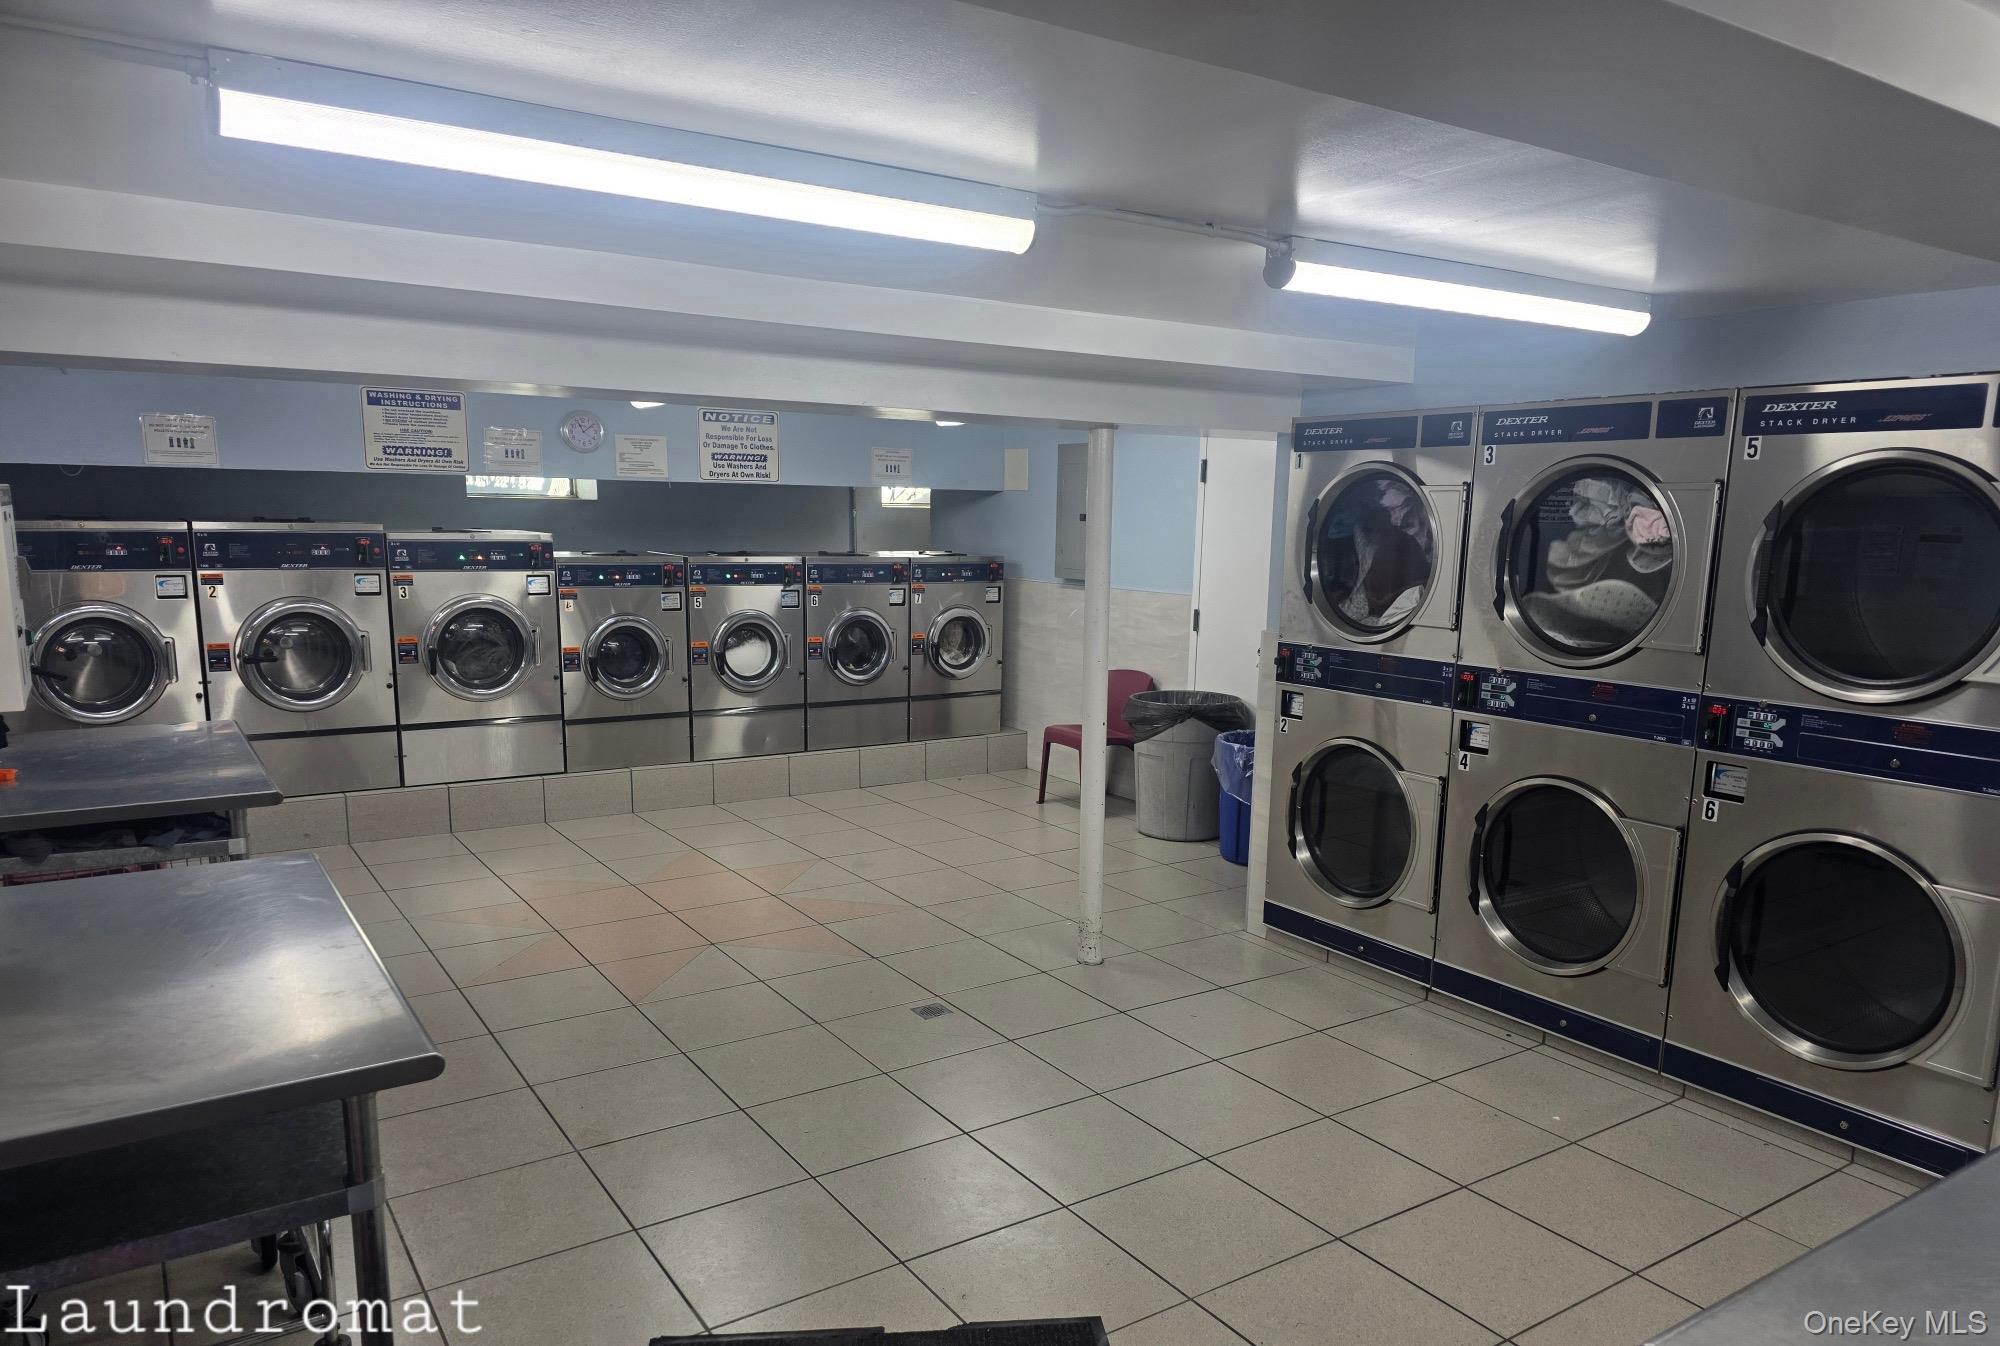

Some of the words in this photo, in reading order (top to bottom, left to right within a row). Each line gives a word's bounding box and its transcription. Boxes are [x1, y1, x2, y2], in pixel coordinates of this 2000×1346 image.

[368, 391, 412, 400] WASHING
[381, 400, 448, 408] INSTRUCTIONS
[1762, 400, 1838, 412] DEXTER
[704, 412, 772, 424] NOTICE
[1496, 416, 1548, 425] DEXTER
[1812, 416, 1856, 425] DRYER
[706, 433, 744, 441] Responsible
[1304, 427, 1343, 436] DEXTER
[386, 447, 448, 456] WARNING!
[1747, 437, 1759, 458] 5
[1486, 446, 1493, 464] 3
[1297, 454, 1301, 468] 1
[208, 586, 216, 598] 2
[400, 586, 406, 598] 3
[696, 597, 701, 607] 5
[812, 596, 817, 605] 6
[916, 594, 921, 603] 7
[1281, 719, 1287, 732] 2
[1460, 754, 1468, 769] 4
[1705, 801, 1715, 819] 6
